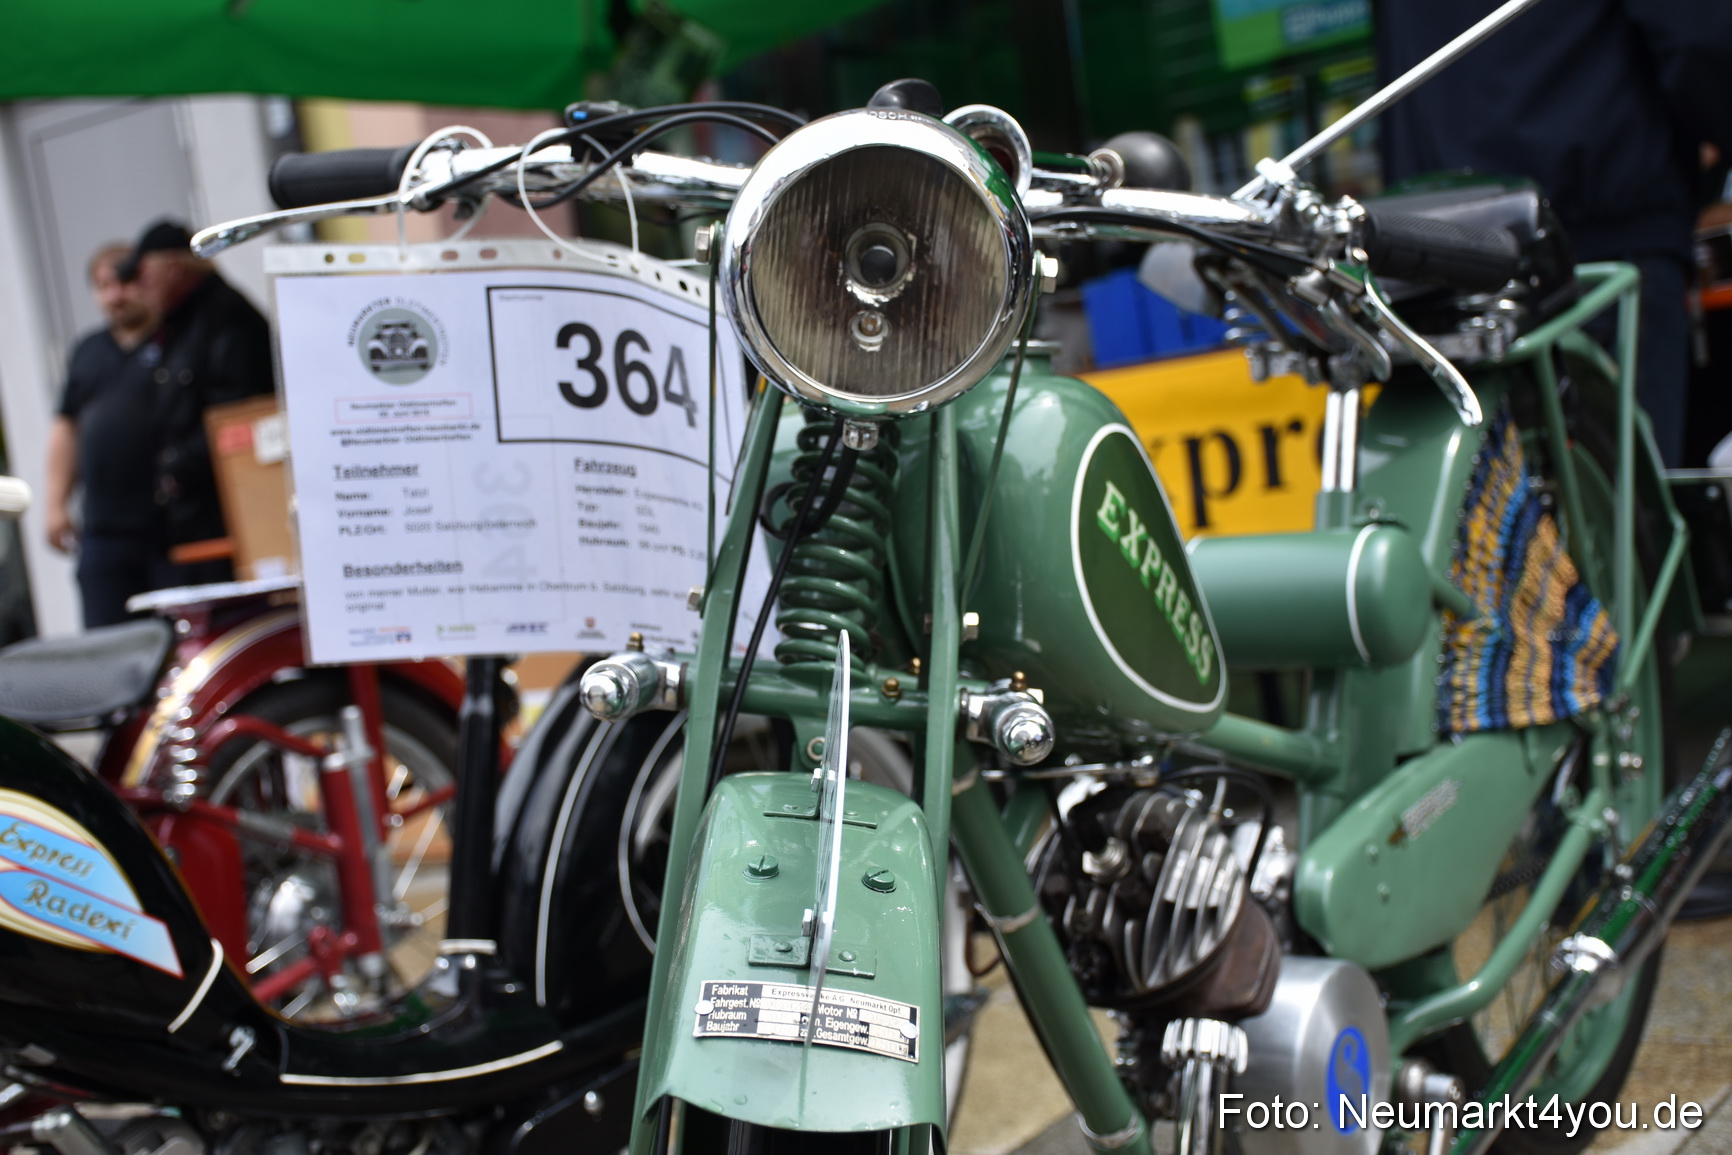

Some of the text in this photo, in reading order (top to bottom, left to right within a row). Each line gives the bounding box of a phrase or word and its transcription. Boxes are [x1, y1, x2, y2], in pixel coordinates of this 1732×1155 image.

[555, 322, 699, 429] 364
[334, 463, 419, 480] Teilnehmer
[574, 458, 637, 478] Fahrzeug
[343, 561, 464, 578] Besonderheiten
[1096, 480, 1215, 686] EXPRESS
[24, 878, 138, 940] Radexi
[711, 984, 749, 996] Fabrikat
[850, 997, 887, 1011] Neumarkt
[708, 1009, 747, 1021] Hubraum
[817, 1003, 844, 1018] Motor
[706, 1020, 740, 1033] Baujahr
[825, 1016, 869, 1036] Eigengew.
